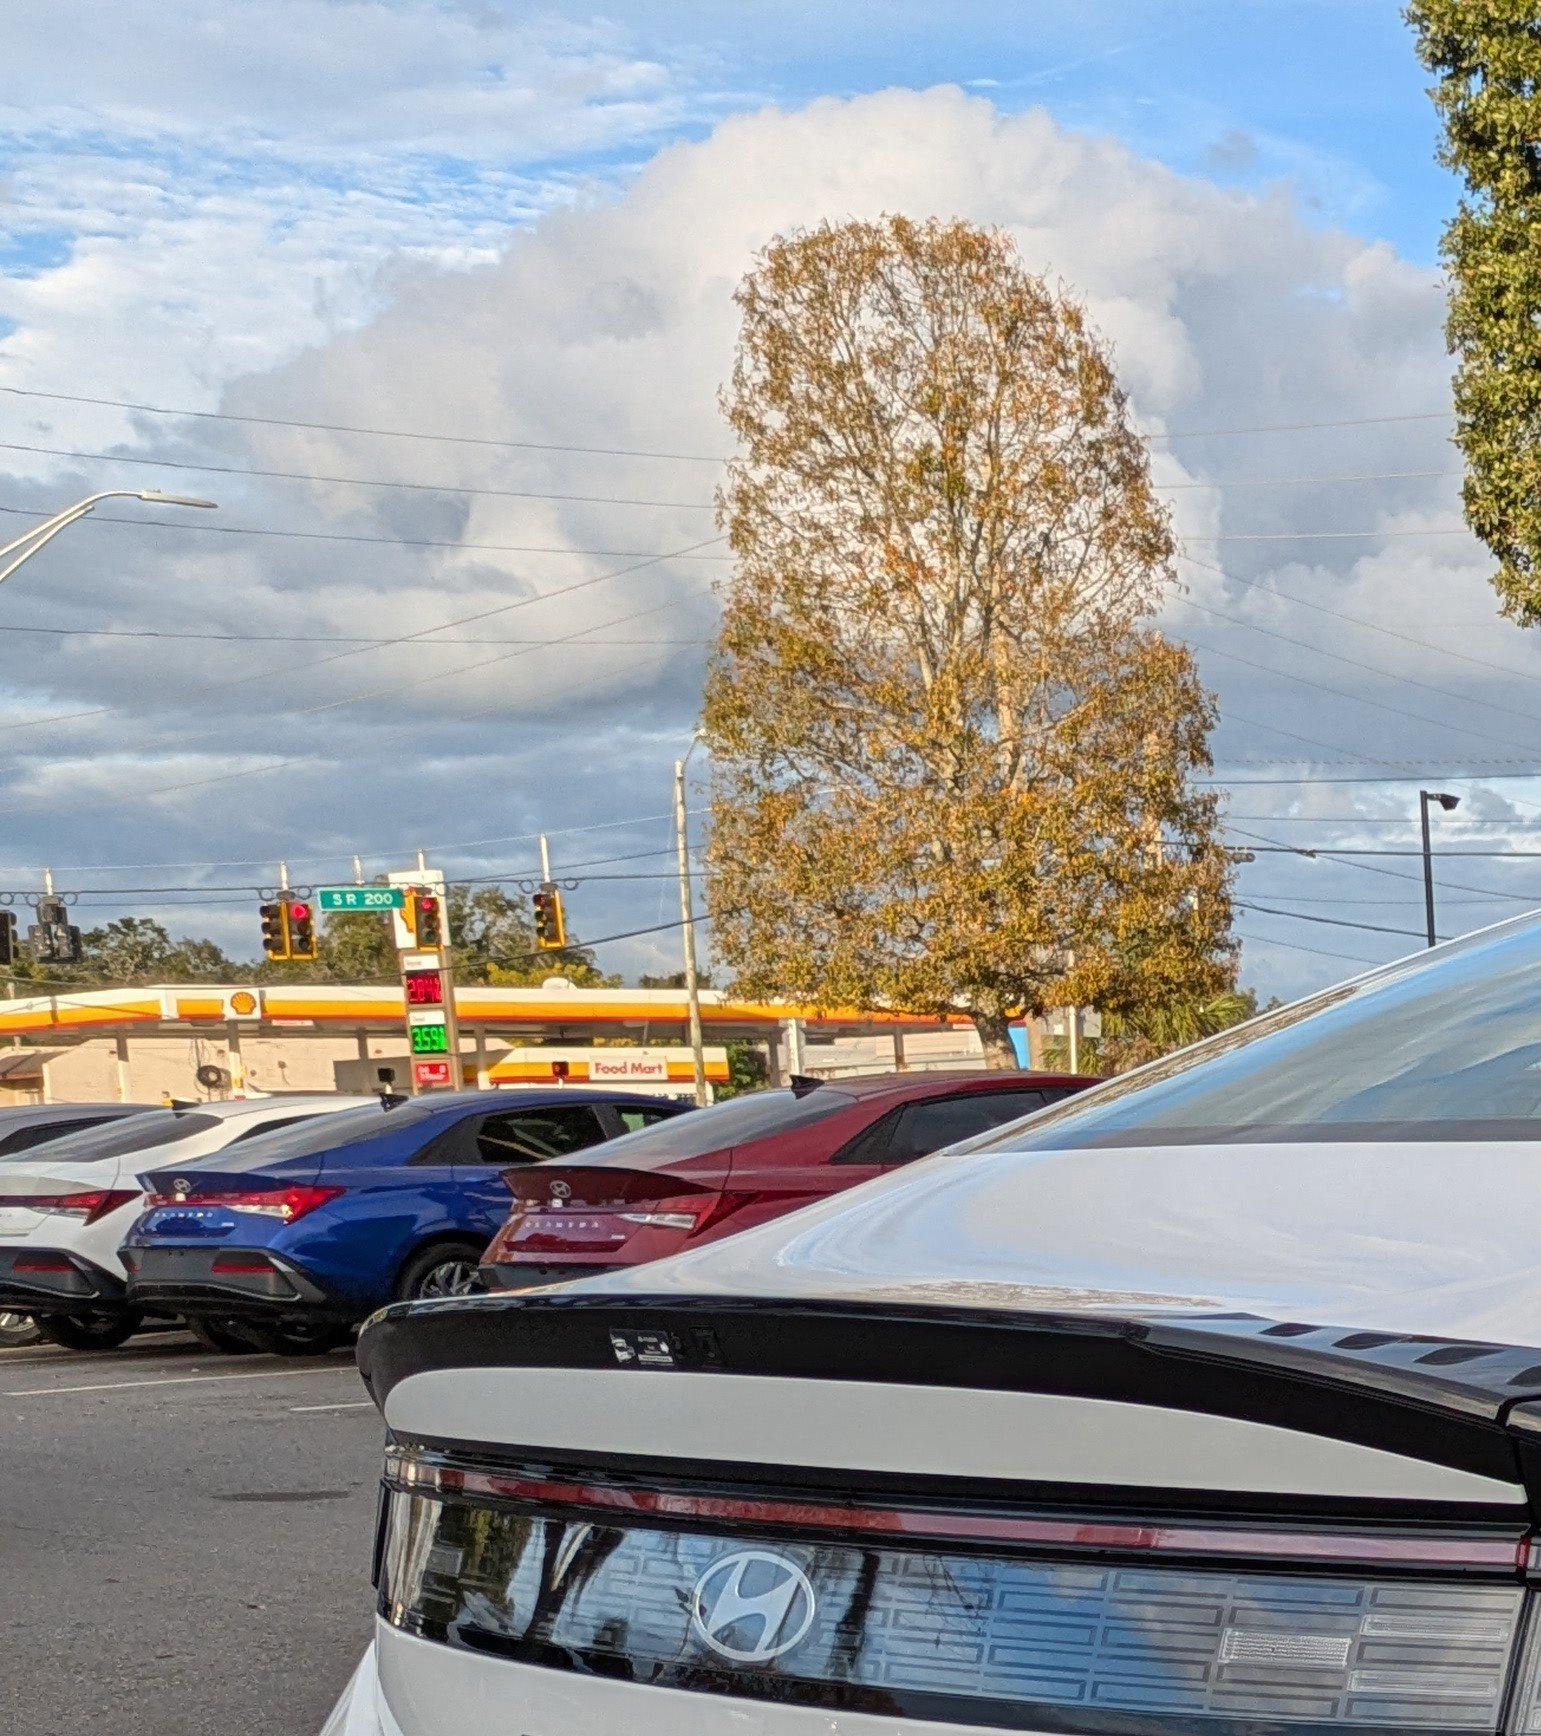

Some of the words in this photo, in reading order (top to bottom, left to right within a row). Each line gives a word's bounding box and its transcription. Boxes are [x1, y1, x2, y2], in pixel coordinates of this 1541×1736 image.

[364, 892, 394, 905] 200
[594, 1061, 628, 1075] Food
[630, 1061, 664, 1075] Mart
